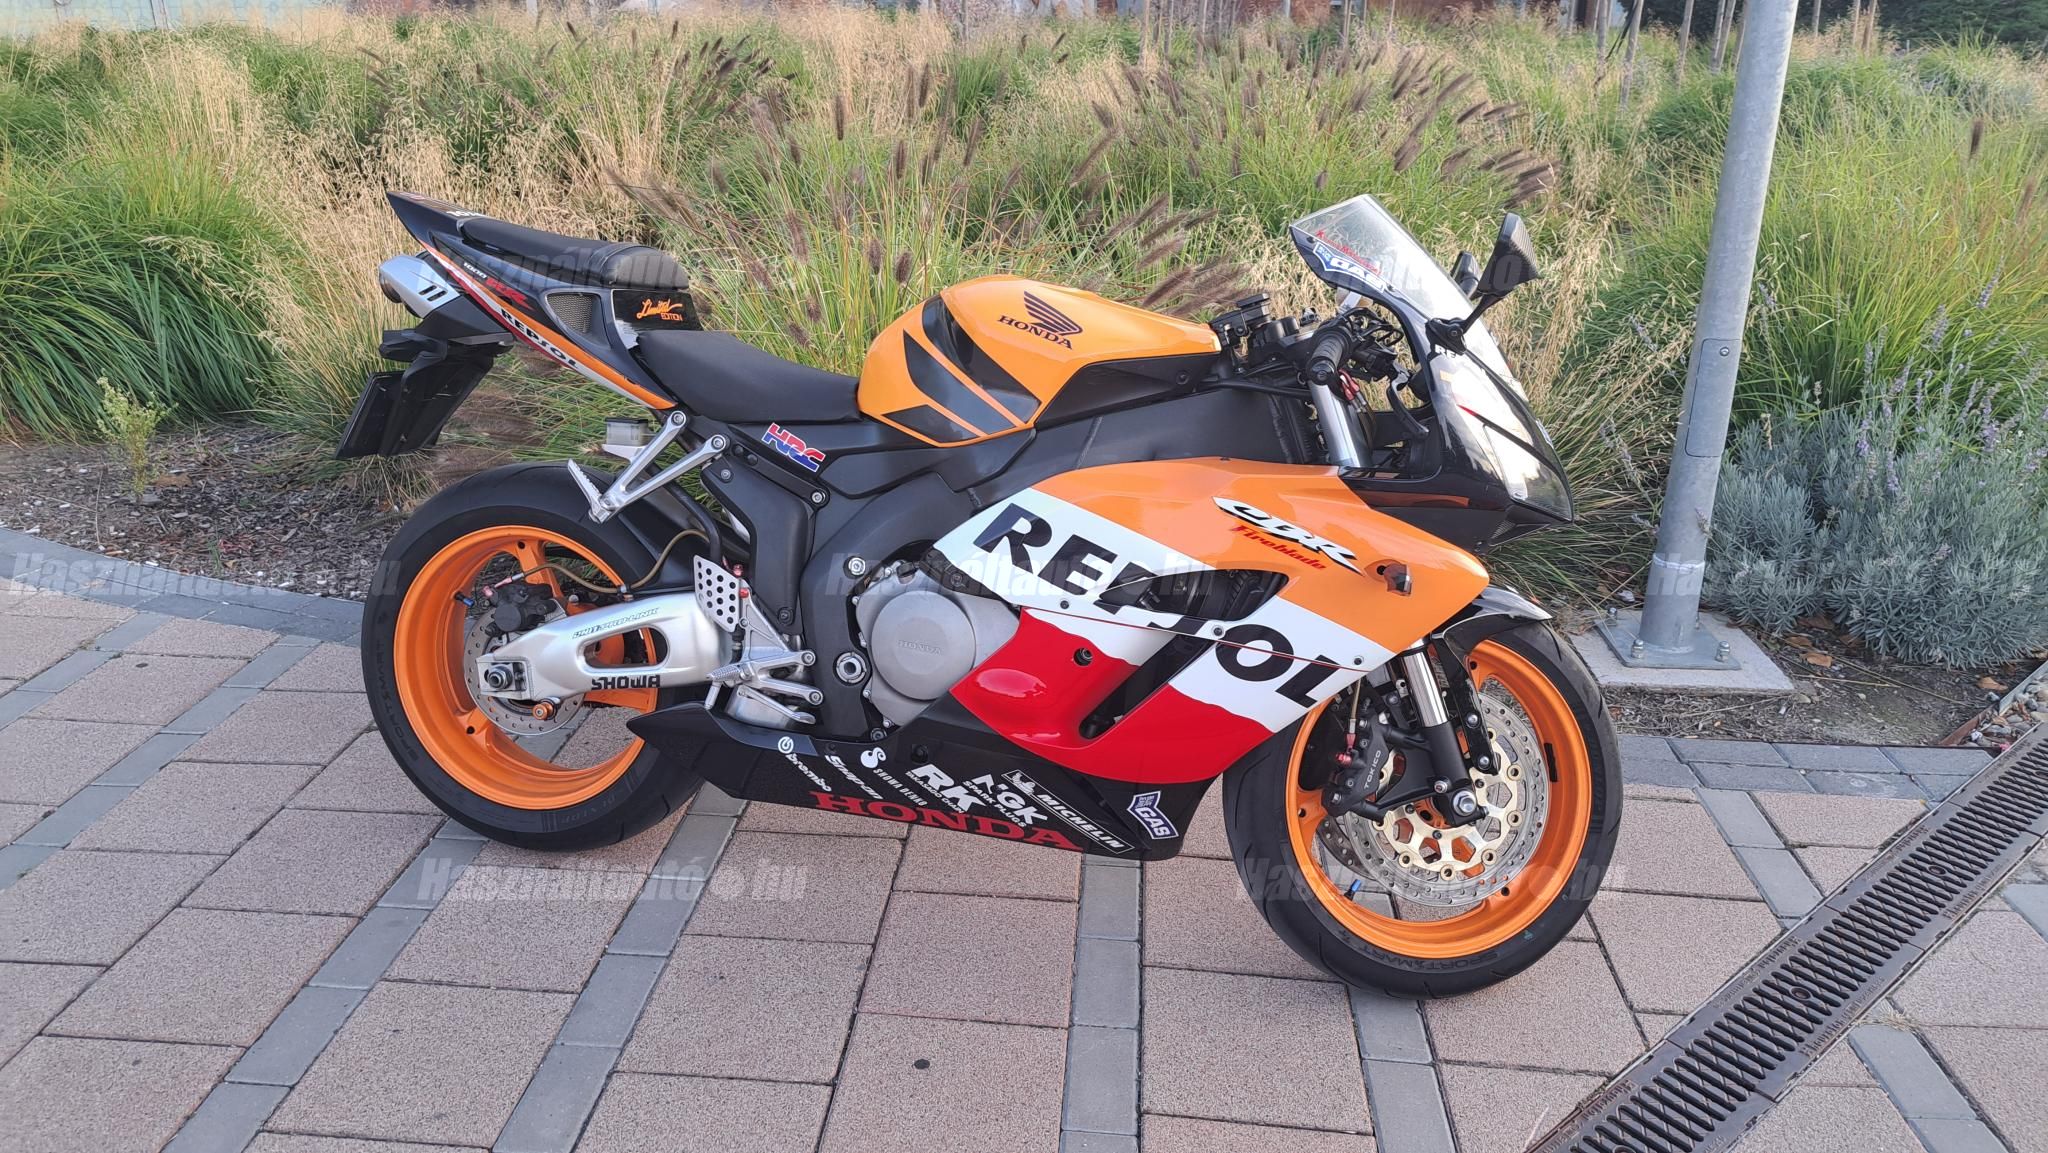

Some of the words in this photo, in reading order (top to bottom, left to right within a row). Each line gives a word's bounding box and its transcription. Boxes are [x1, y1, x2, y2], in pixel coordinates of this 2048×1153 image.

[463, 261, 488, 279] 1000
[500, 308, 579, 370] REPSOL
[660, 312, 683, 322] EDITION
[997, 315, 1074, 350] HONDA
[762, 422, 826, 473] HRC
[1212, 496, 1366, 577] CBR
[1230, 525, 1327, 570] Fireblade
[898, 639, 943, 655] HONDA
[591, 674, 661, 690] SHOWA
[786, 753, 832, 792] brembo
[824, 755, 884, 800] Snap-on
[873, 768, 903, 789] SHOWA
[899, 785, 928, 806] DENKO
[911, 763, 987, 812] RK
[1363, 749, 1383, 790] TOKICO
[905, 771, 942, 798] TAKASAGO
[941, 797, 965, 814] CHAIN
[963, 780, 996, 804] SPARK
[994, 803, 1027, 828] PLUGS
[971, 773, 1048, 825] NGK
[809, 790, 1084, 853] HONDA
[1036, 794, 1125, 849] MICHELIN
[1135, 807, 1171, 836] GAS
